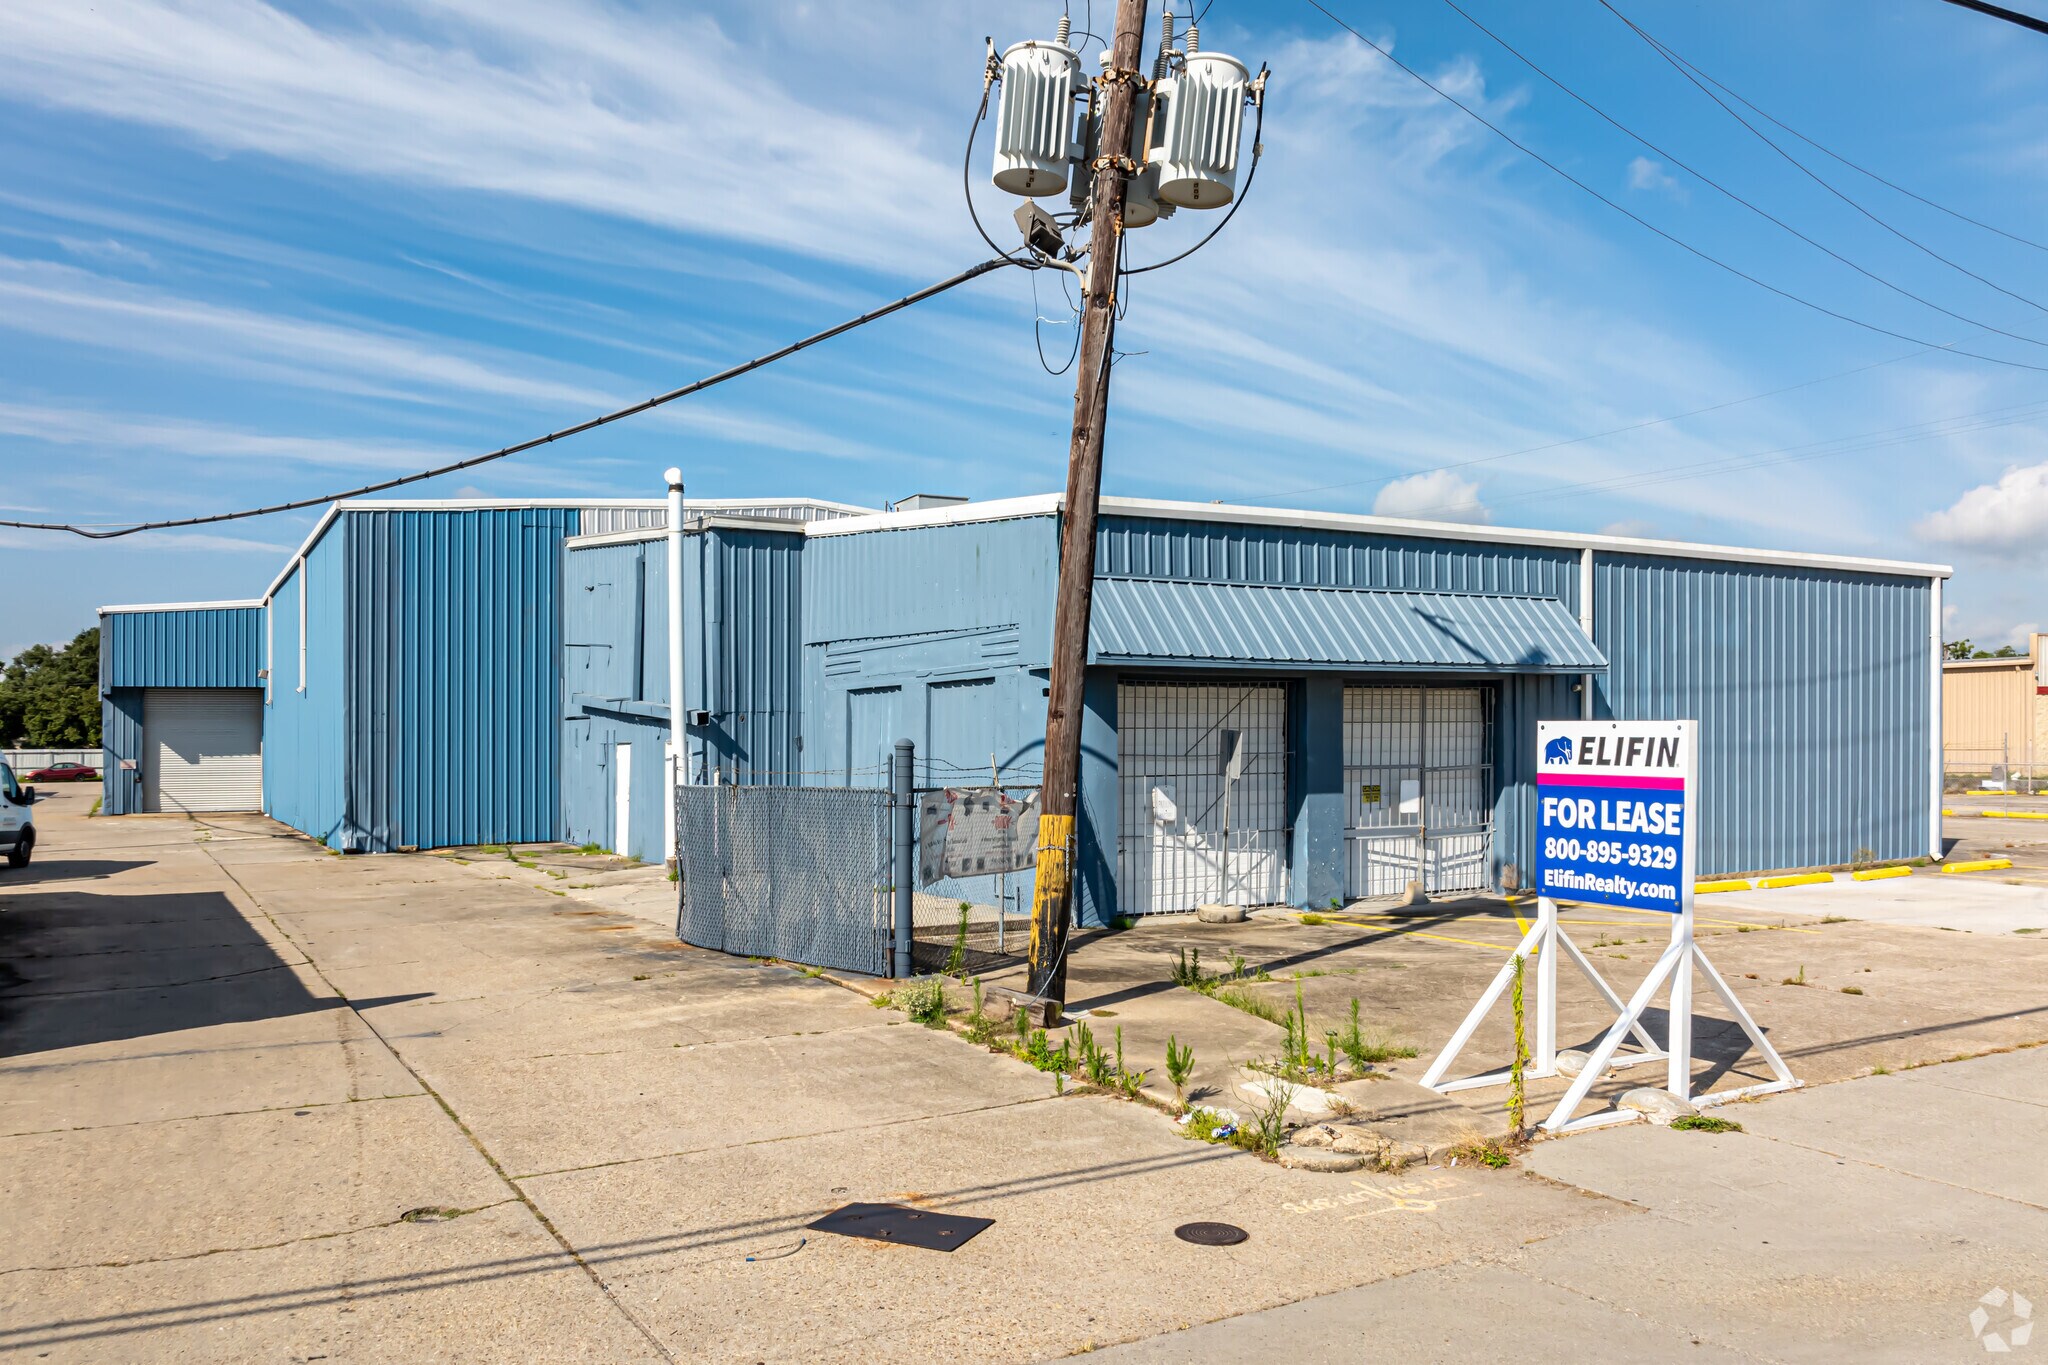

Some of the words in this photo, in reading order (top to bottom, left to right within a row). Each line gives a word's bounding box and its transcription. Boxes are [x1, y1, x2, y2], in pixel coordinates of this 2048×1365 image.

[1578, 736, 1680, 768] ELIFIN
[1543, 797, 1596, 830] FOR
[1601, 799, 1681, 836] LEASE
[1545, 837, 1677, 870] 800-895-9329
[1544, 868, 1676, 900] ElifinRealty.com
